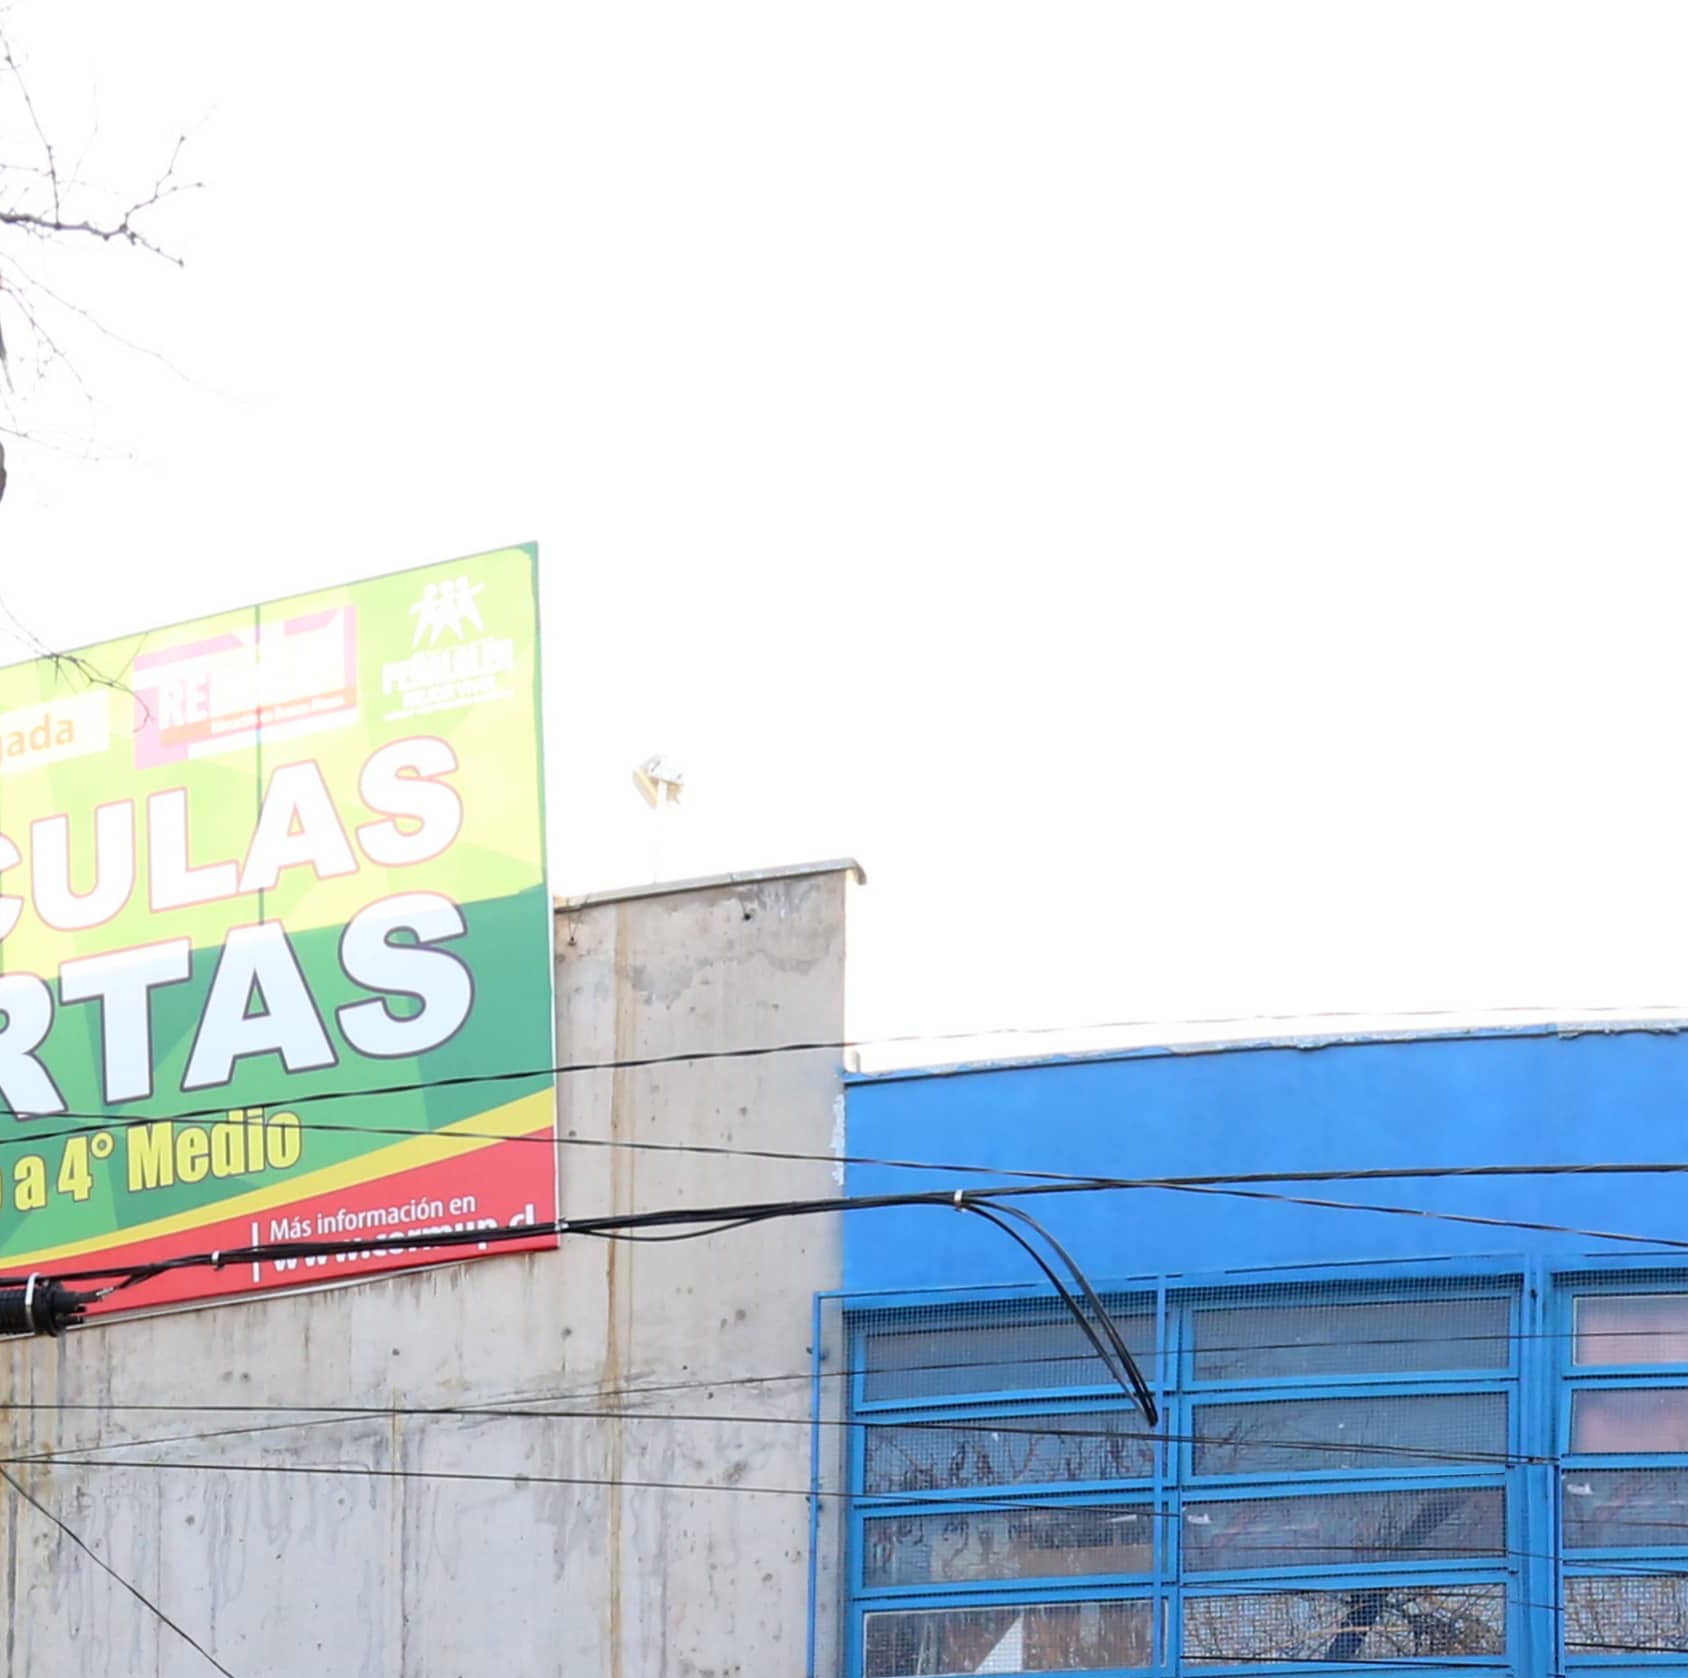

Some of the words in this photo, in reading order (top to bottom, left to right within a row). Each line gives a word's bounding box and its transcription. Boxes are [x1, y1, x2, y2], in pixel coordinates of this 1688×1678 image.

[14, 1155, 47, 1212] a
[126, 1108, 302, 1192] Medio
[270, 1217, 312, 1243] Más
[317, 1197, 444, 1235] información
[449, 1195, 476, 1215] en
